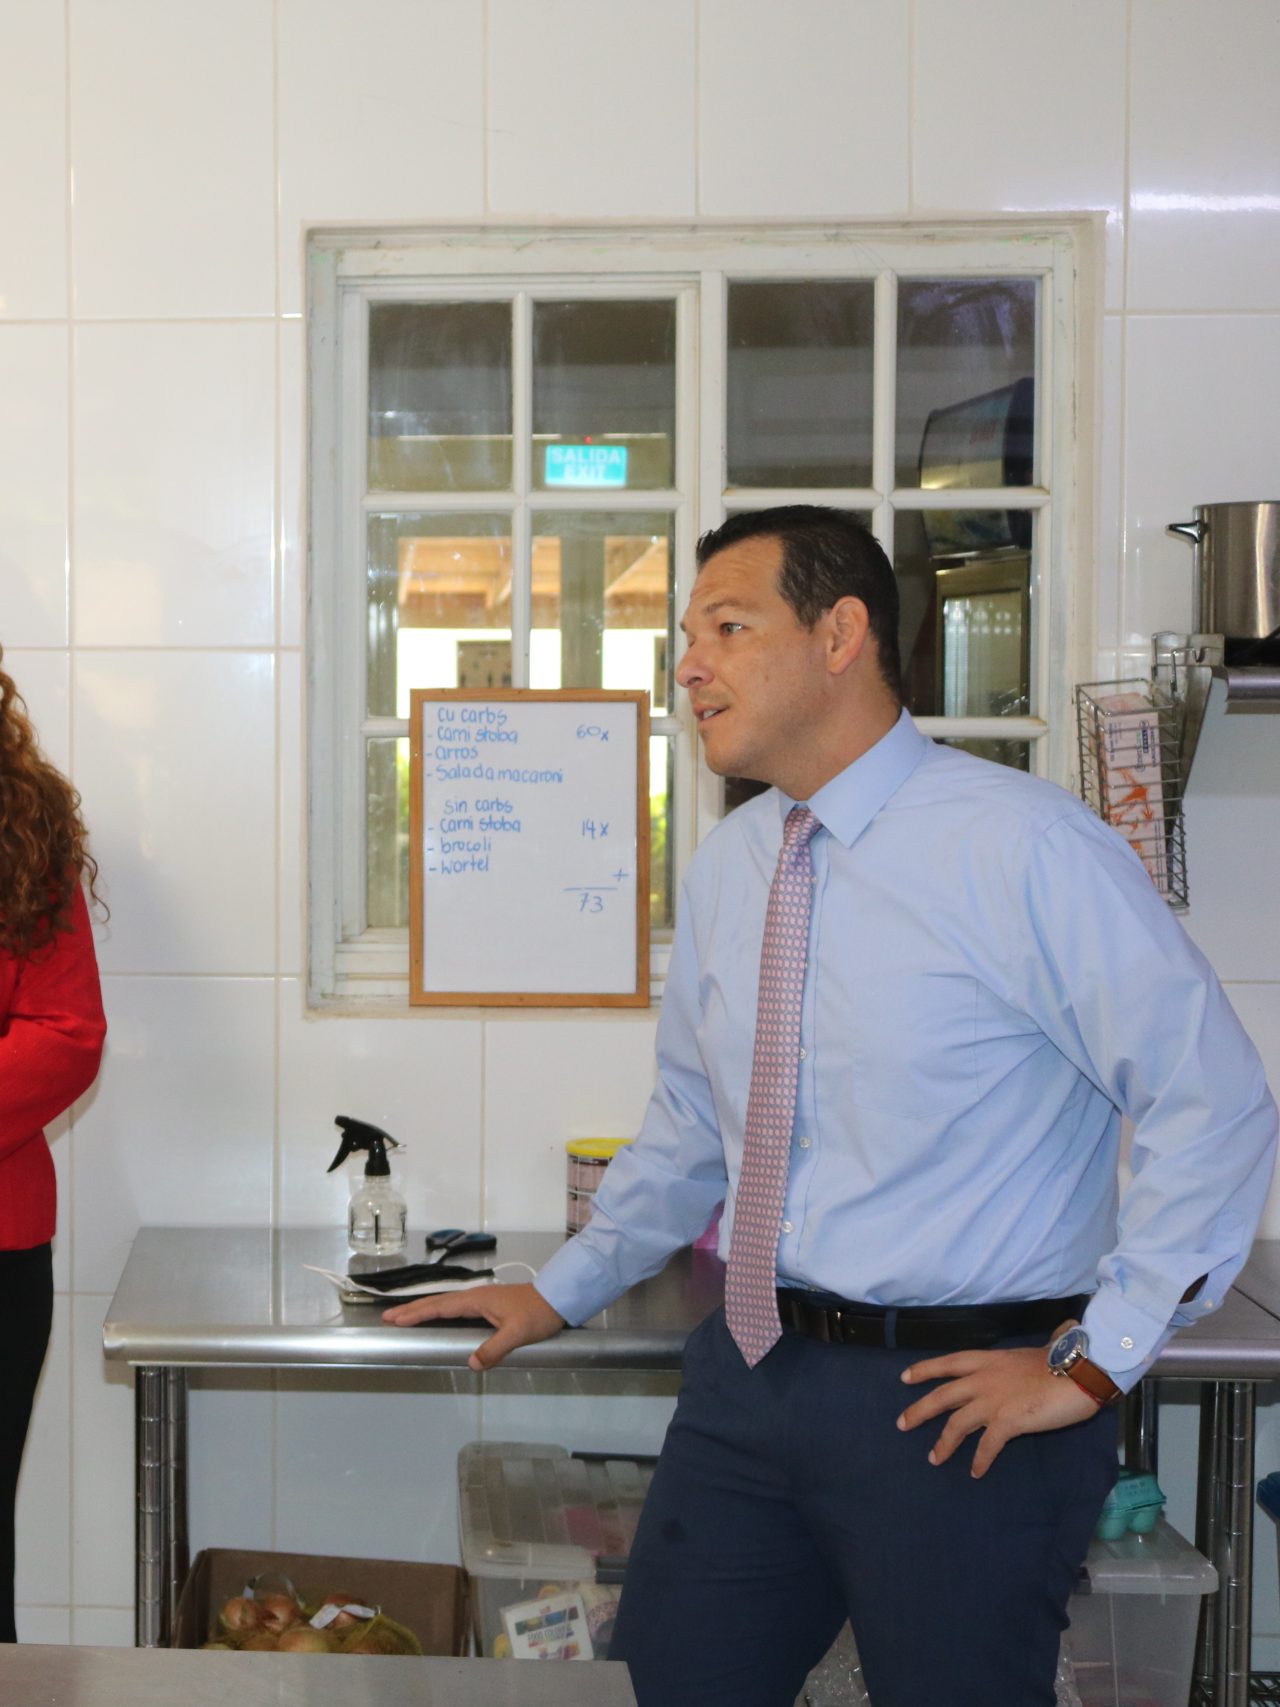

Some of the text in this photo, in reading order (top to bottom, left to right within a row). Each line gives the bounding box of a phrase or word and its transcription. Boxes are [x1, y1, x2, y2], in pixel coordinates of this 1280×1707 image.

[551, 447, 621, 464] SALIDA
[564, 464, 606, 481] EXIT
[435, 745, 478, 760] arros
[440, 836, 491, 854] brocoli
[580, 892, 603, 913] 73
